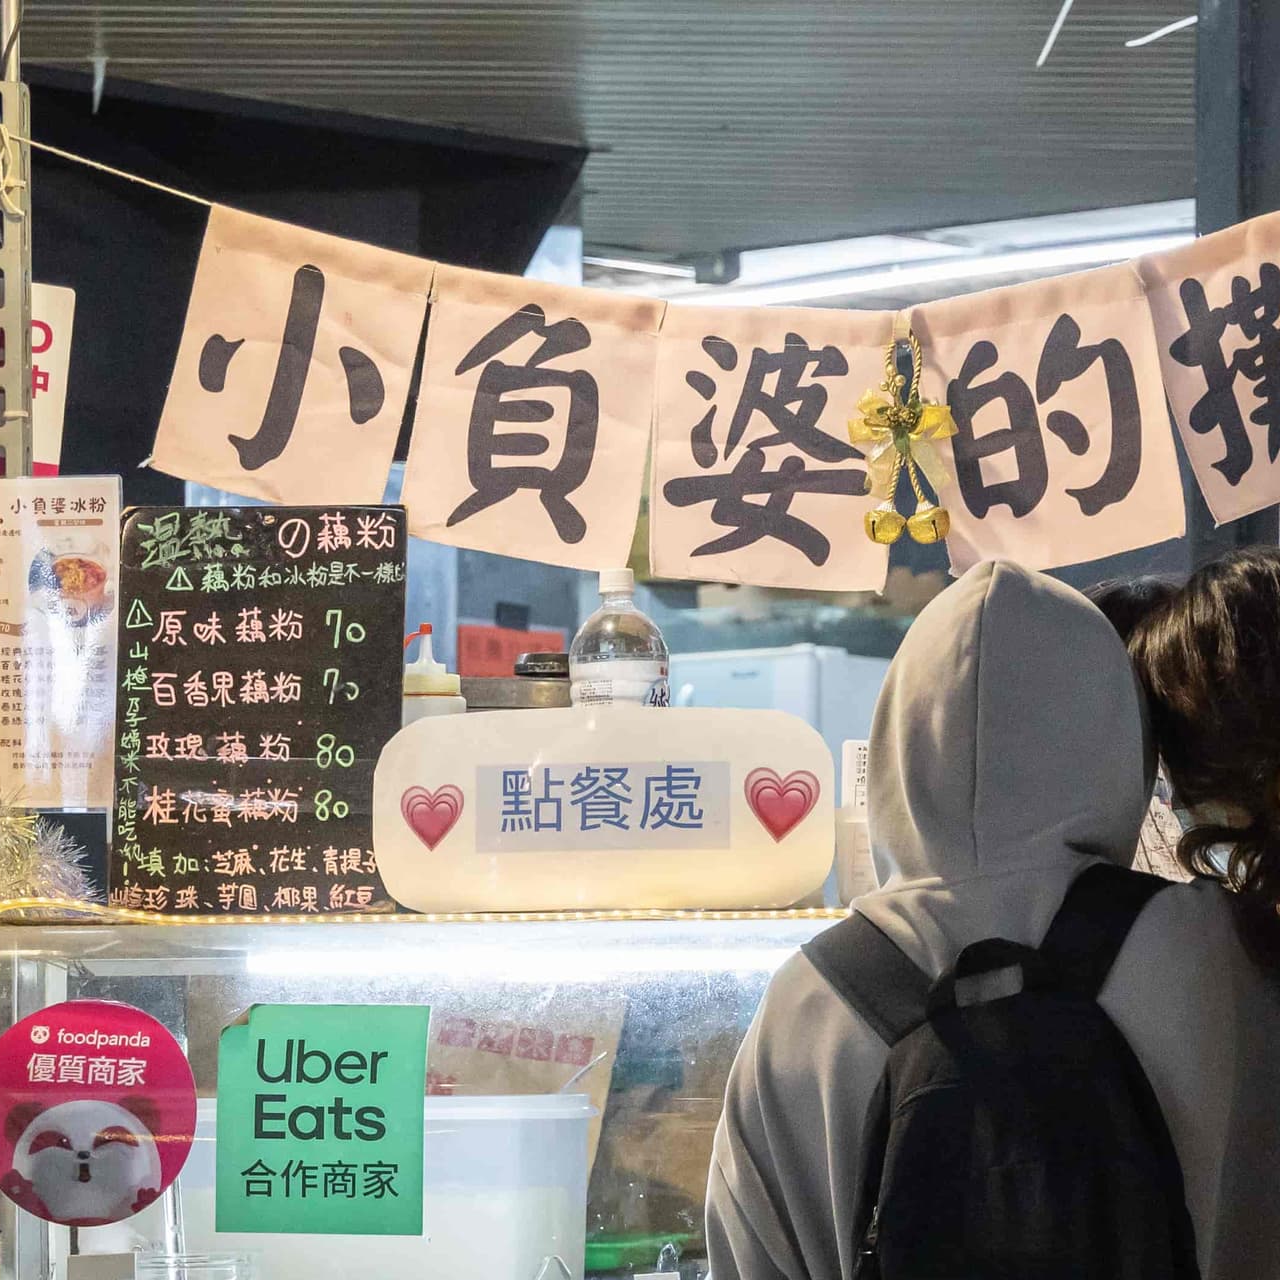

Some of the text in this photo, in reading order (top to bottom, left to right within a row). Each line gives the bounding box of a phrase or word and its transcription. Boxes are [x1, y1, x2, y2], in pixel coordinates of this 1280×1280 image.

[325, 609, 366, 649] 70
[316, 733, 355, 769] 80
[314, 789, 349, 821] 80
[501, 764, 704, 834] 點餐處
[57, 1028, 151, 1049] foodpanda
[26, 1052, 148, 1087] 優質商家
[255, 1038, 389, 1085] Uber
[254, 1093, 387, 1142] Eats
[240, 1158, 400, 1200] 合作商家
